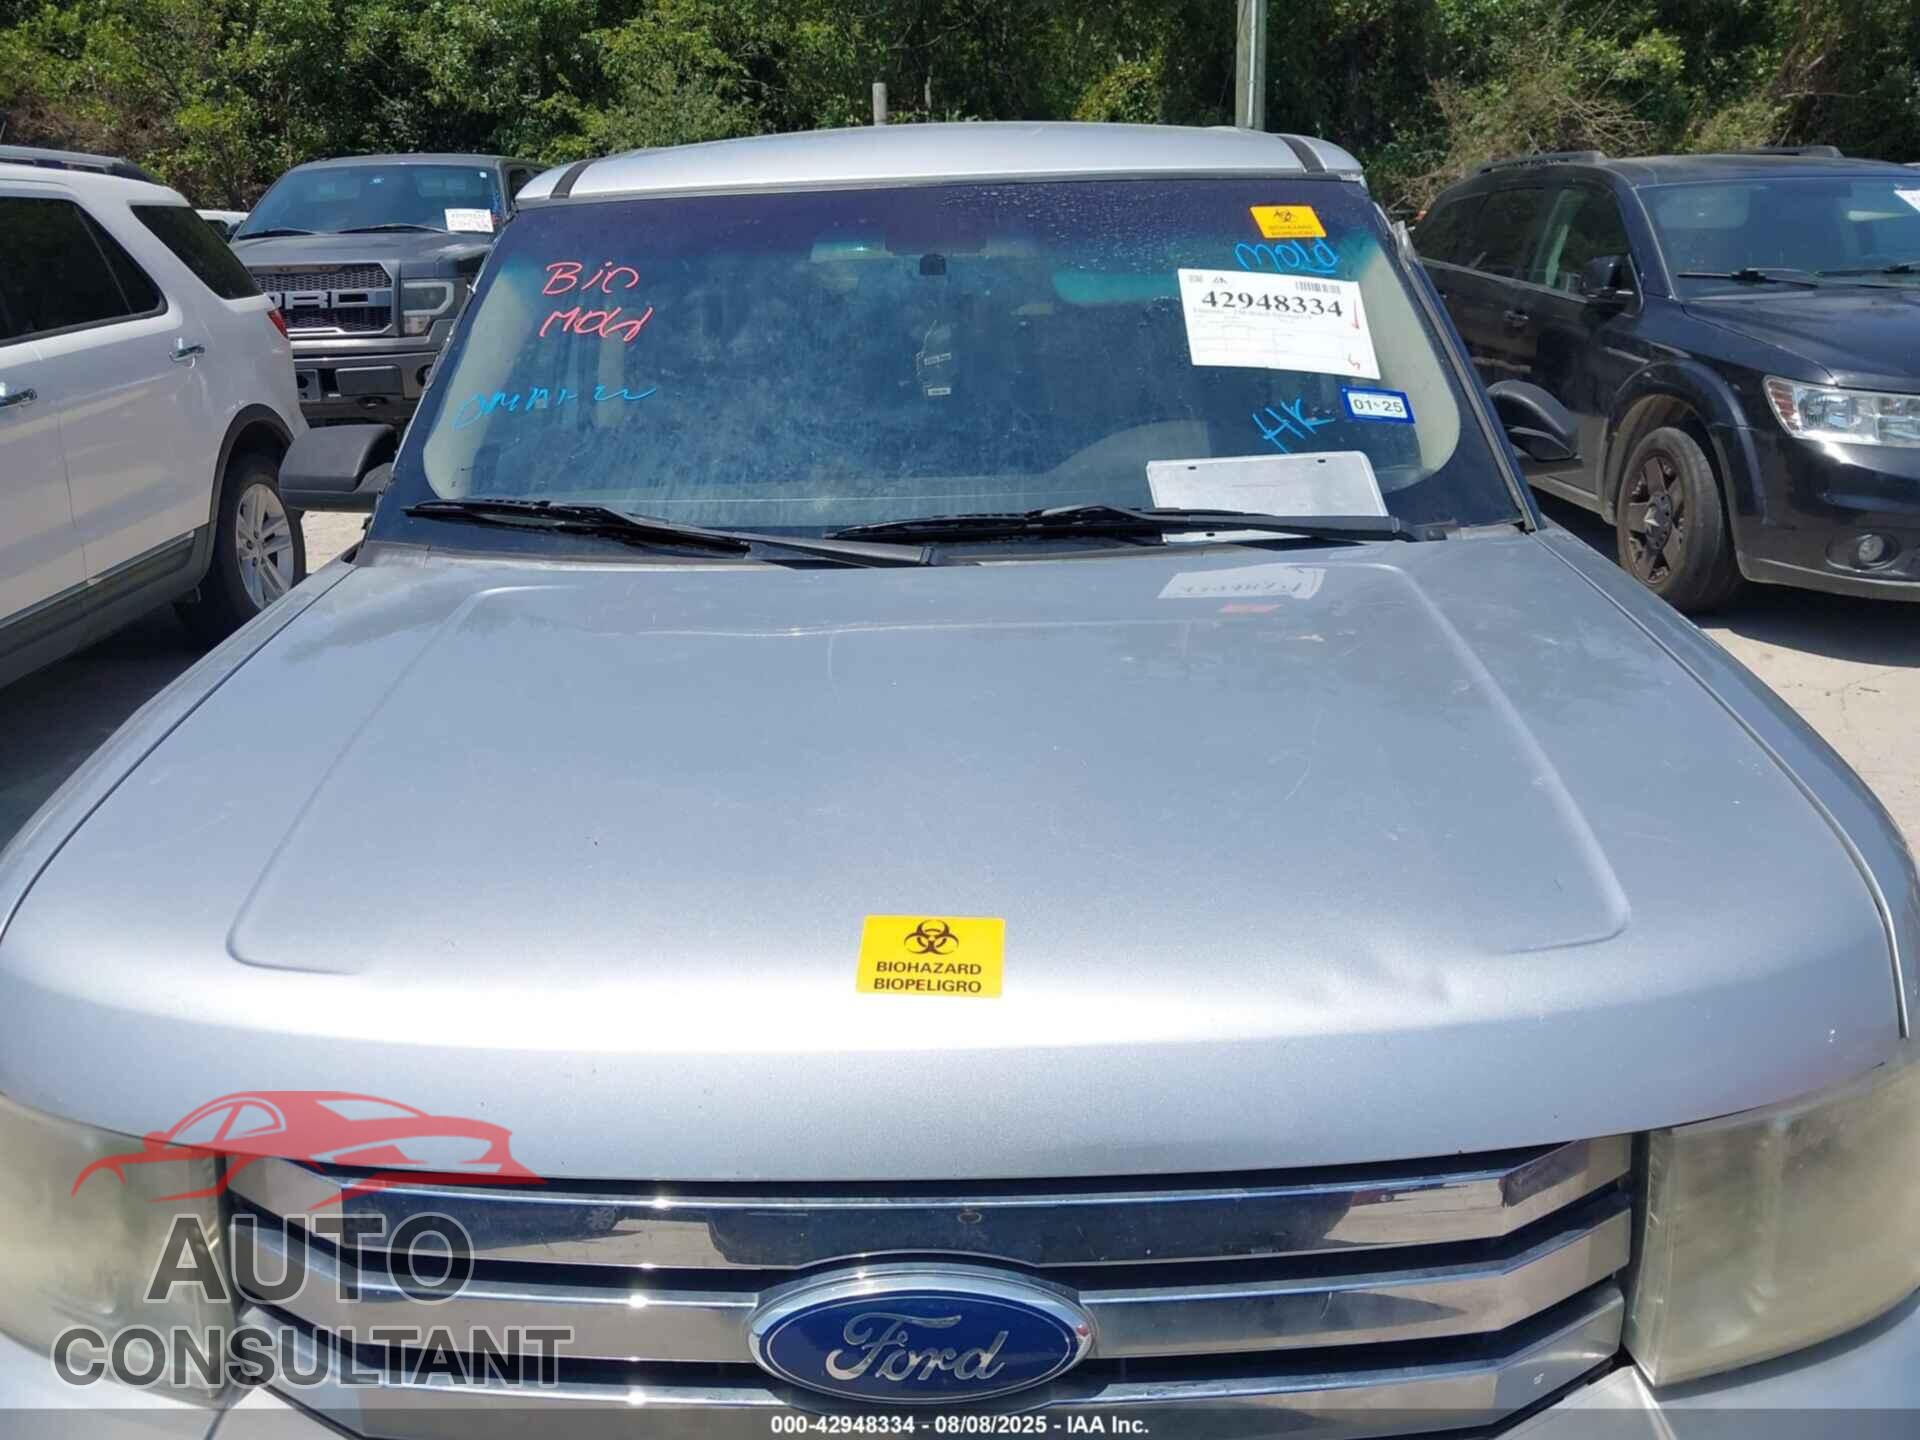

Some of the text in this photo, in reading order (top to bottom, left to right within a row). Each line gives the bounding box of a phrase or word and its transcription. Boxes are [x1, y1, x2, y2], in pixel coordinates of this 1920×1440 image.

[1201, 290, 1343, 318] 42948334
[876, 961, 982, 975] BIOHAZARD
[873, 977, 982, 993] BIOPELIGRO
[825, 1312, 1008, 1382] Ford
